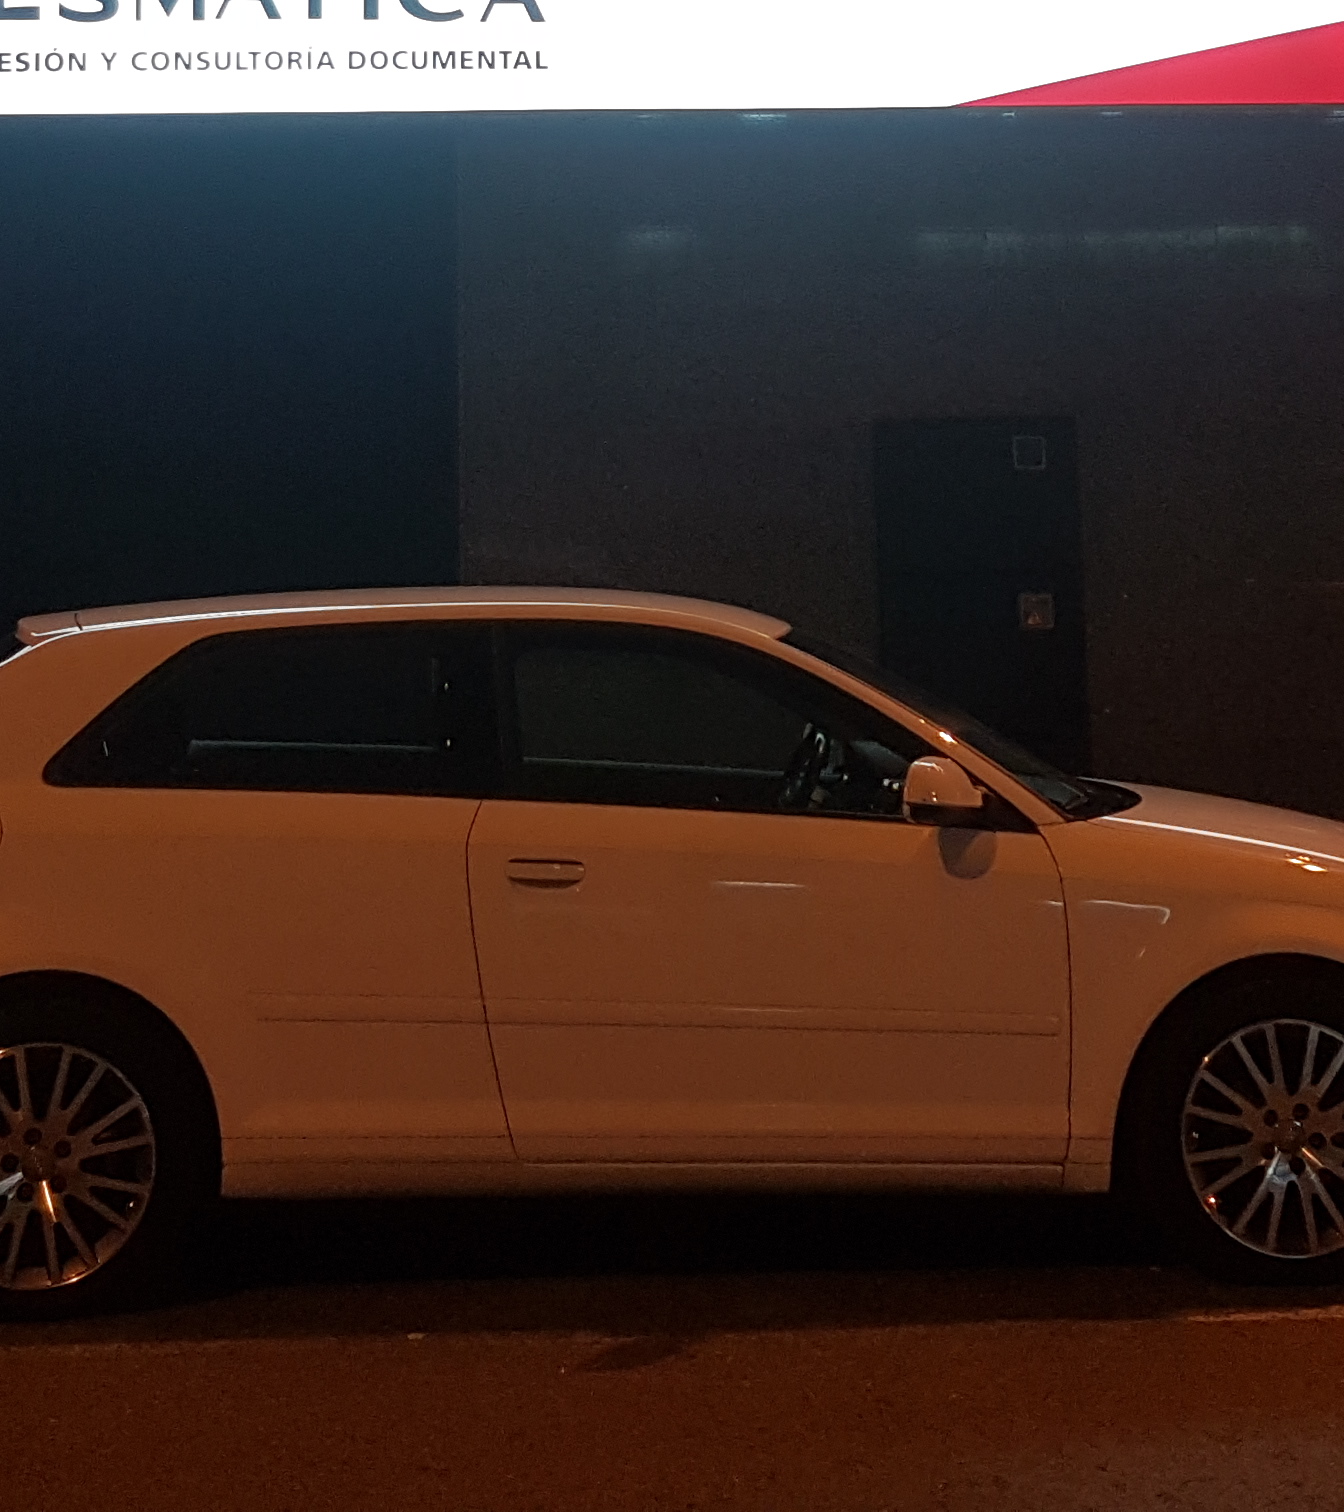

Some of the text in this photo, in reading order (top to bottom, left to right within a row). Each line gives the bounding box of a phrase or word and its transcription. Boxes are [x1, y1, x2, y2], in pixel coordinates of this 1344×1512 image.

[102, 53, 118, 71] Y
[132, 47, 336, 71] CONSULTORÍA
[349, 51, 549, 70] DOCUMENTAL
